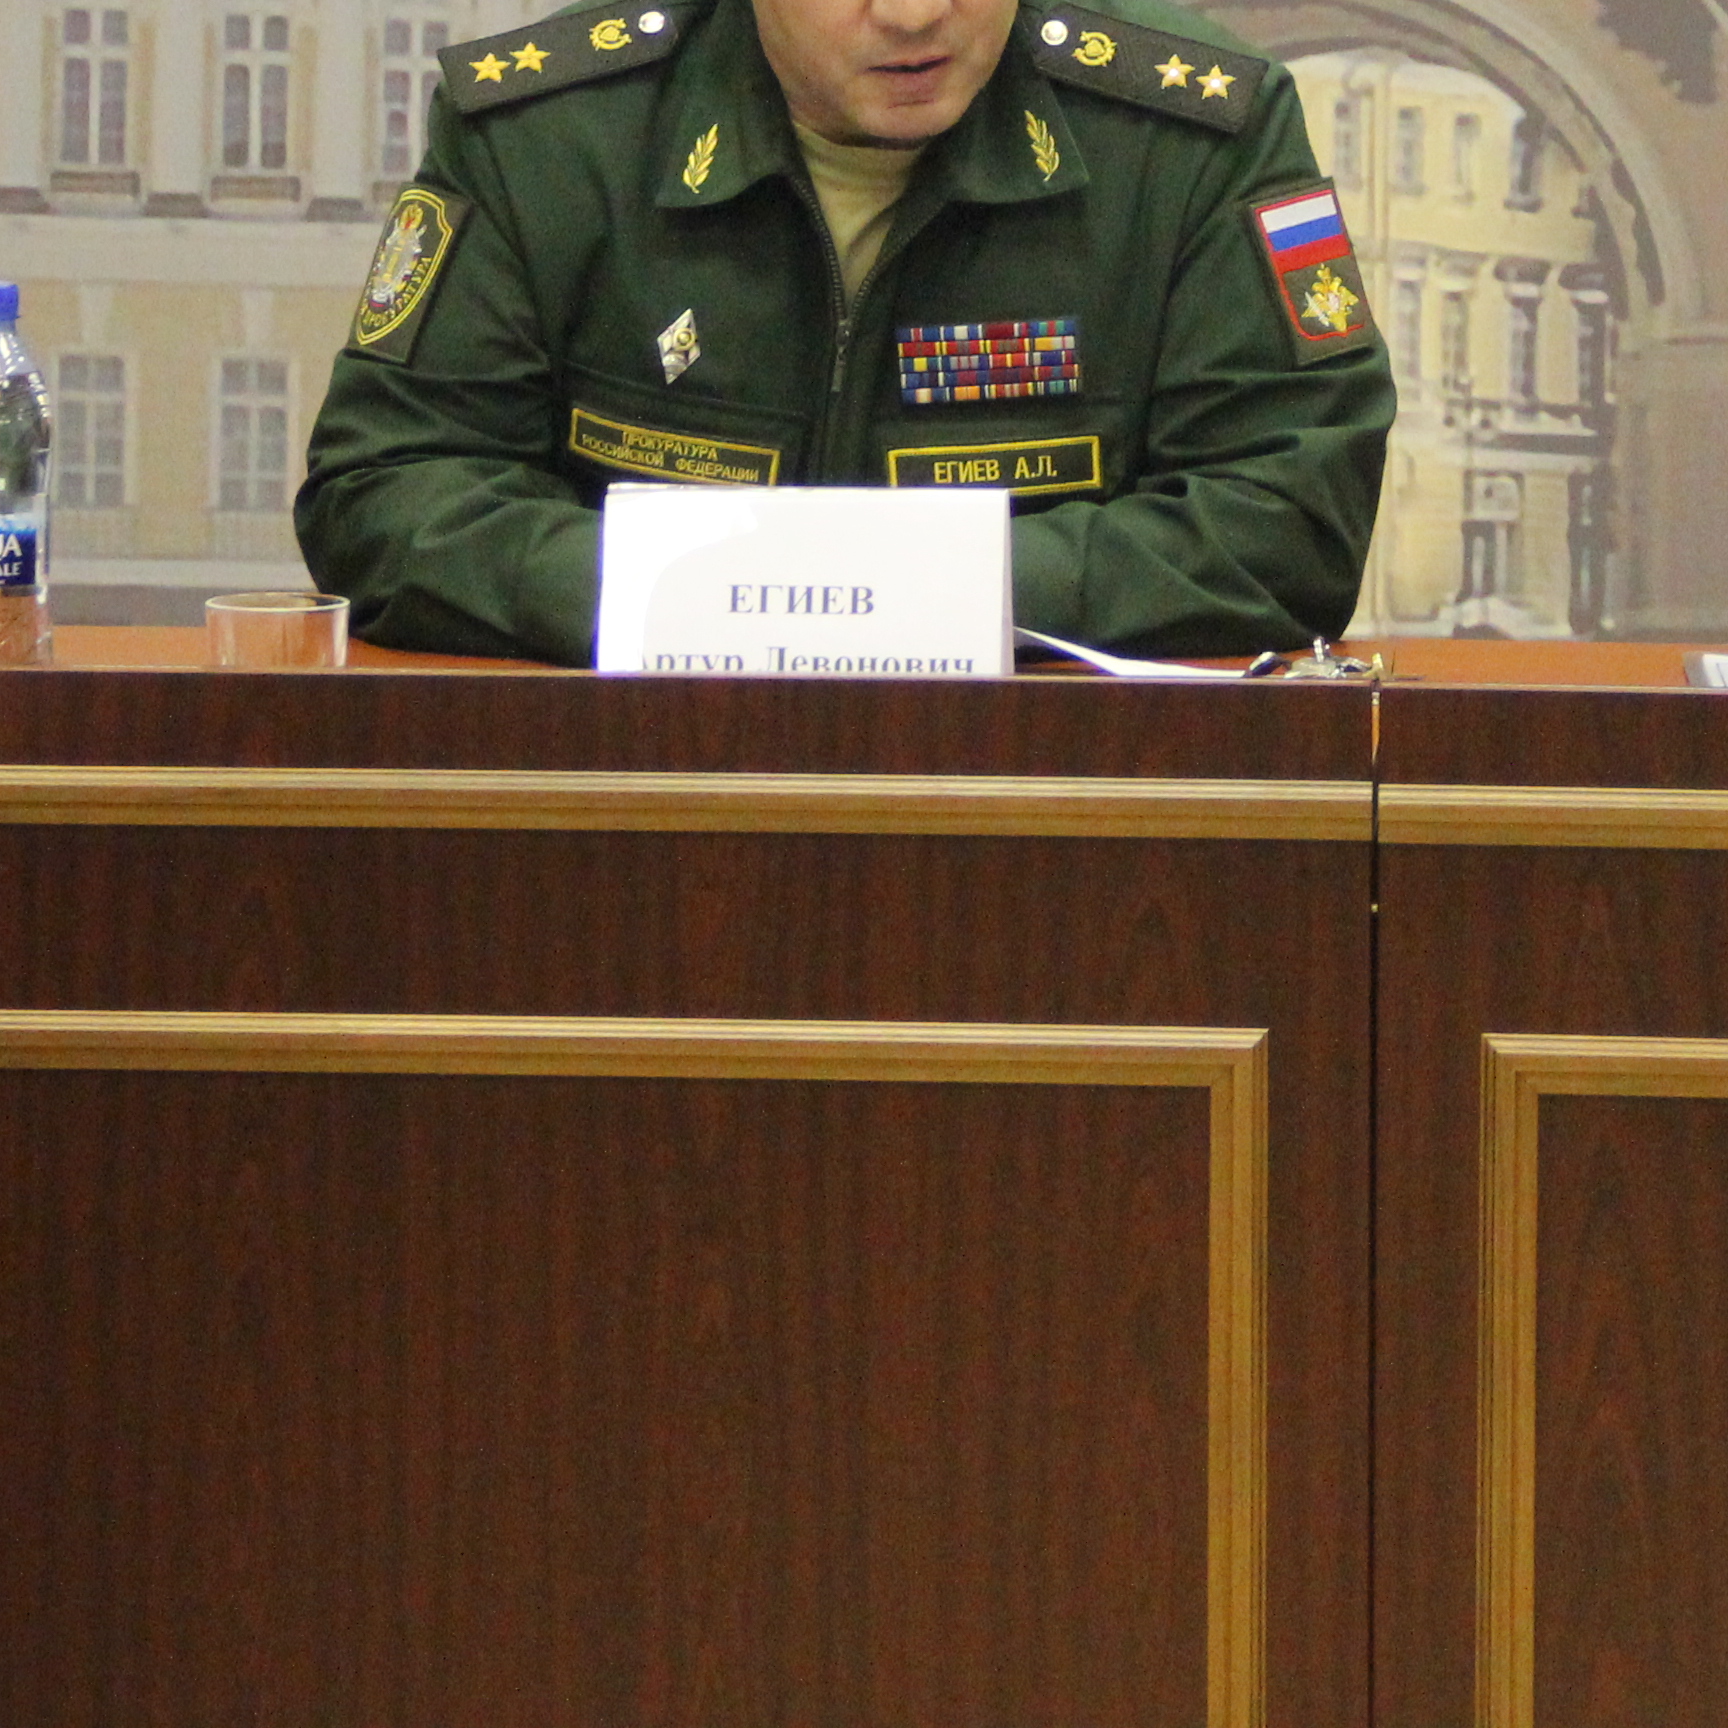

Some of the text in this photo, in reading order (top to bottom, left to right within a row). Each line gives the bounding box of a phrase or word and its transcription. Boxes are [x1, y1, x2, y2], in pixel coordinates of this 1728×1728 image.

[582, 433, 759, 483] РОССИЙСКОЙ ФЕДЕРАЦИИ
[622, 431, 718, 461] ПРОКУРАТУРА
[933, 455, 1058, 484] ЕГИЕВ А.Л.
[728, 584, 875, 615] ЕГИЕВ
[641, 646, 975, 673] ртур Левонович
